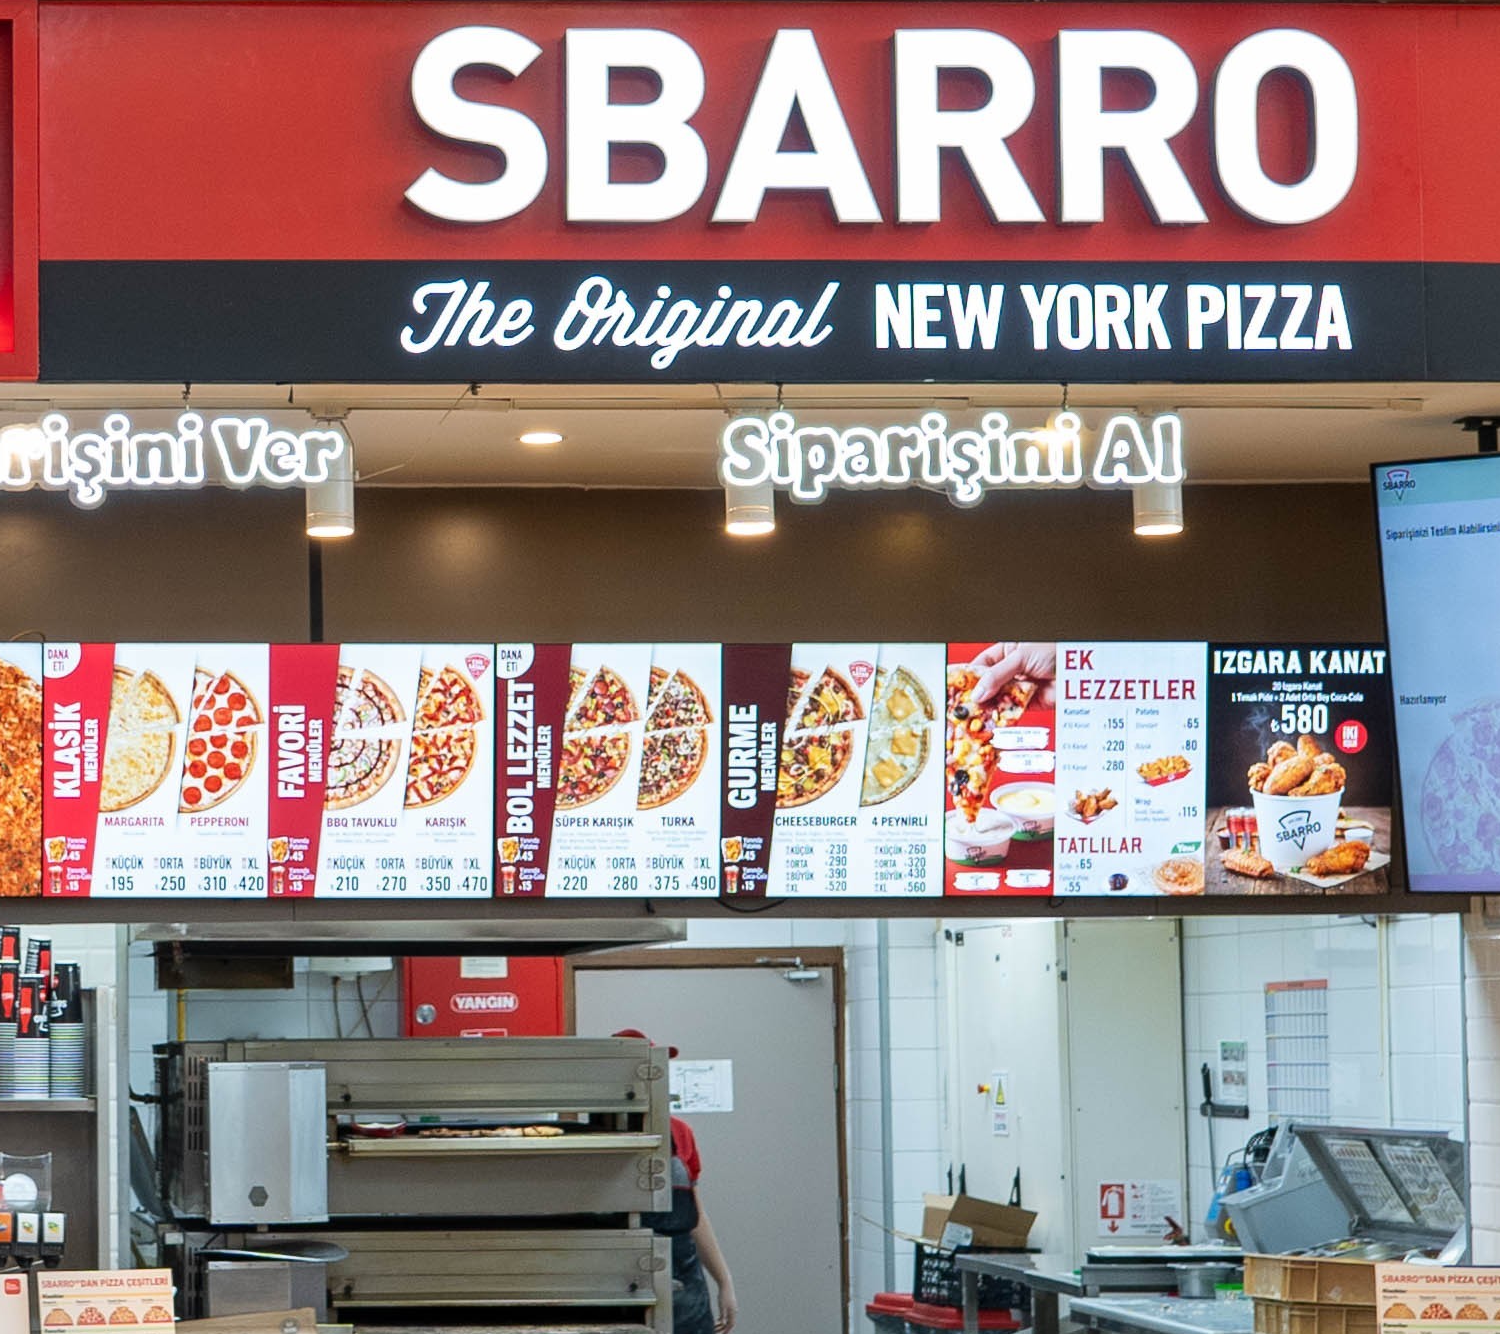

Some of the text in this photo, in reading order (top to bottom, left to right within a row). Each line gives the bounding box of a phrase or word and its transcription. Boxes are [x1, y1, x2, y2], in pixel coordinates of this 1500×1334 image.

[404, 26, 1361, 224] SBARRO
[401, 279, 1353, 371] The Original NEW YORK PIZZA
[212, 418, 344, 484] Ver
[721, 411, 1185, 507] Siparişini Al
[1382, 478, 1416, 492] SBARRO
[1385, 525, 1429, 542] Siparişinizi
[1430, 524, 1457, 538] Teslim
[48, 649, 69, 660] DANA
[501, 649, 522, 660] DANA
[1065, 649, 1094, 670] EK
[1213, 650, 1386, 675] IZGARA KANAT
[1064, 679, 1196, 700] LEZZETLER
[53, 701, 81, 798] KLASİK
[82, 718, 99, 782] MENÜLER
[273, 704, 305, 799] FAVORİ
[307, 718, 323, 783] MENÜLER
[506, 679, 534, 834] BOL LEZZET
[537, 725, 553, 789] MENÜLER
[728, 704, 758, 809] GURME
[760, 721, 777, 792] MENÜLER
[104, 817, 165, 828] MARGARITA
[190, 817, 249, 828] PEPPERONI
[326, 817, 398, 828] BBQ TAVUKLU
[555, 814, 589, 828] SÜPER
[660, 816, 696, 827] TURKA
[775, 816, 857, 827] CHEESEBURGER
[882, 814, 928, 827] PEYNİRLİ
[1275, 820, 1322, 844] SBARRO
[1058, 837, 1142, 854] TATLILAR
[381, 857, 405, 869] ORTA
[611, 857, 636, 869] ORTA
[203, 876, 264, 892] 310 420
[382, 876, 487, 892] 270 350 470
[613, 875, 716, 891] 280 375 490
[453, 995, 516, 1011] YANGIN
